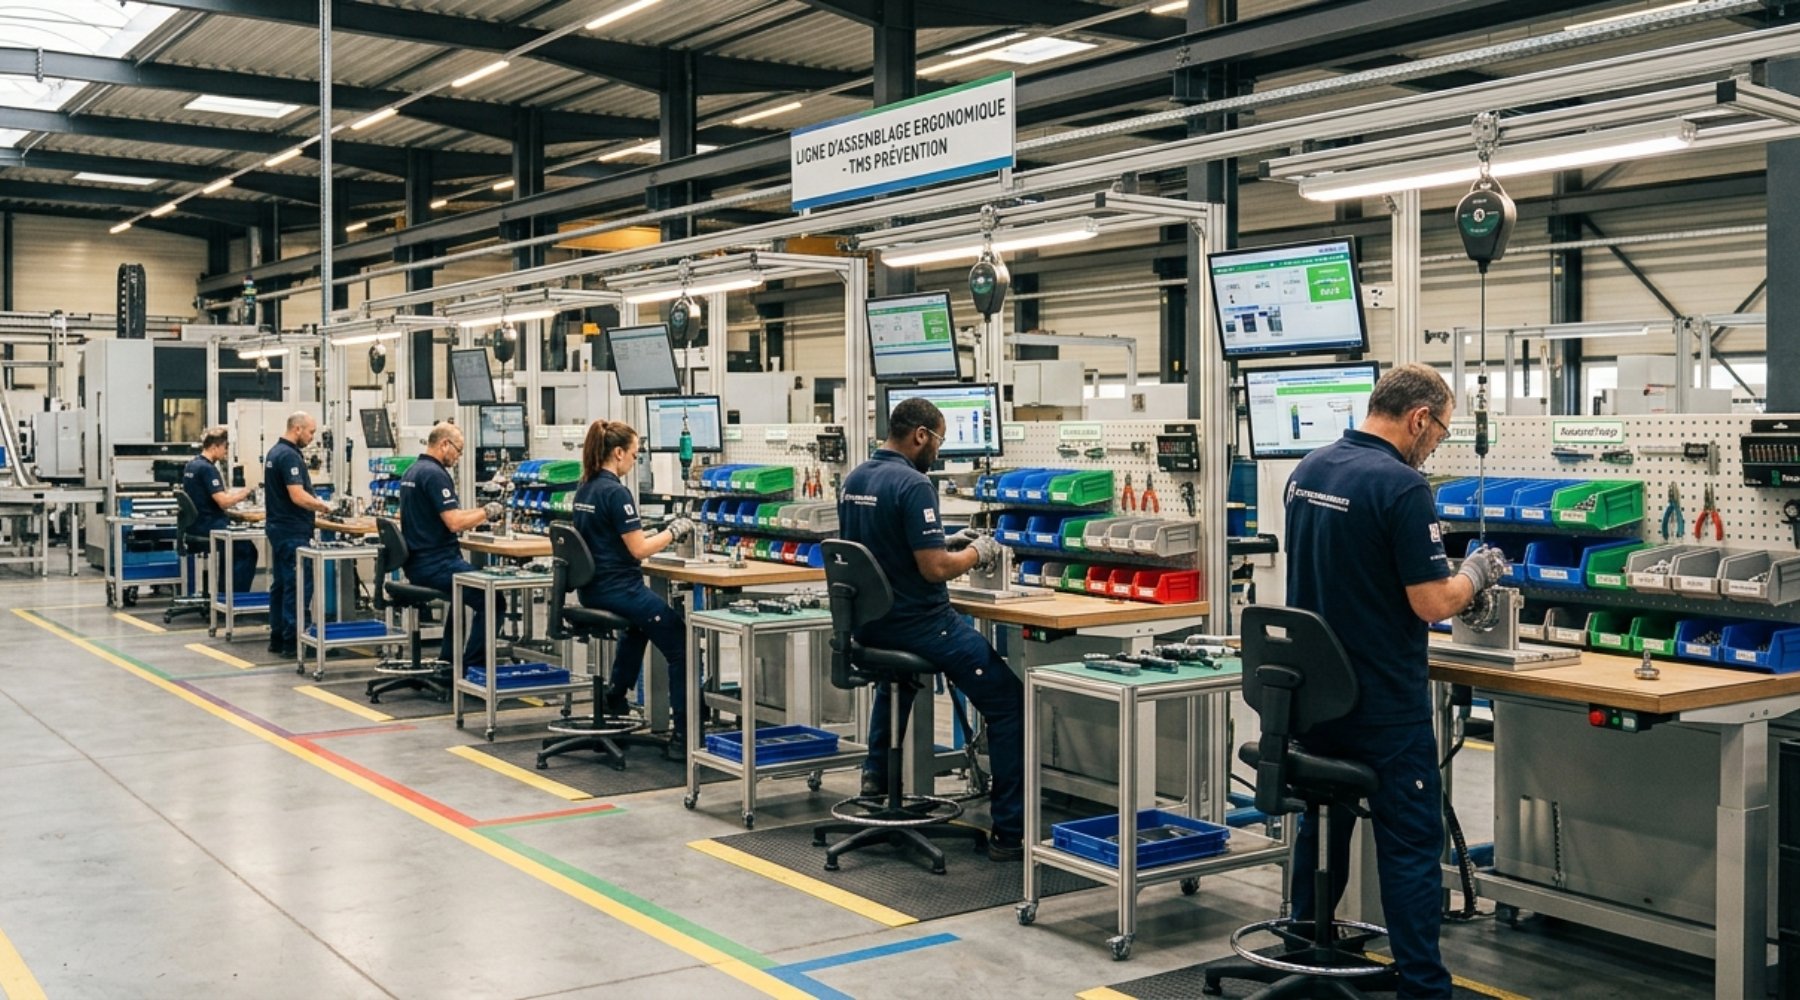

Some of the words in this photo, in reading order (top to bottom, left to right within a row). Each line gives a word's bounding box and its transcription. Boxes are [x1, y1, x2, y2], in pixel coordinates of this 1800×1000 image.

[796, 143, 826, 166] LIGNE
[914, 97, 1006, 136] ERGONOMIQUE
[848, 155, 872, 175] TMS
[874, 137, 948, 170] PRÉVENTION
